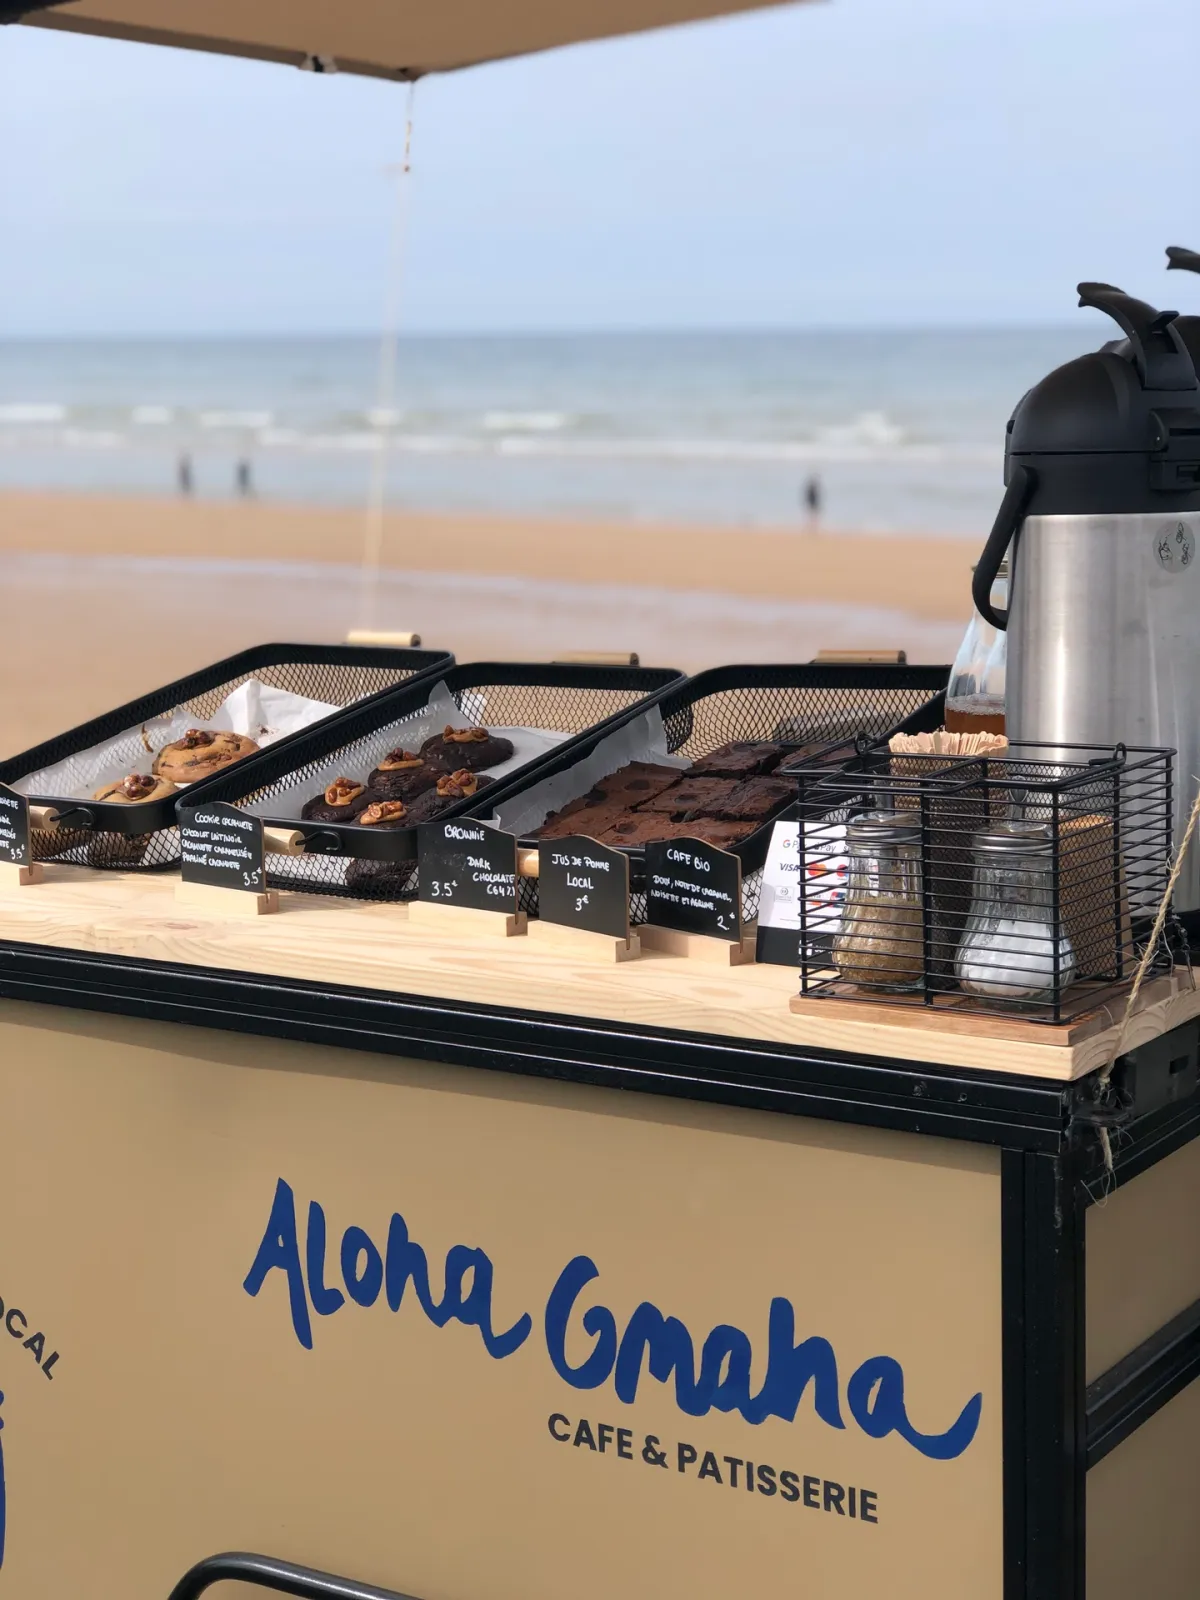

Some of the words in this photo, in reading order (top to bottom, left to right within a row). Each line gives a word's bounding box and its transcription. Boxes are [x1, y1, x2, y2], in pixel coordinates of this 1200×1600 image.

[466, 856, 491, 871] DARK
[551, 853, 570, 866] JUS
[571, 856, 582, 867] DE
[583, 856, 610, 872] POMME
[666, 848, 692, 865] CAFE
[472, 872, 516, 884] CHOCOLATE
[566, 872, 595, 890] LOCAL
[681, 897, 690, 905] ET
[548, 1413, 633, 1460] CAFE
[641, 1434, 668, 1469] &
[677, 1442, 878, 1524] PATISSERIE
